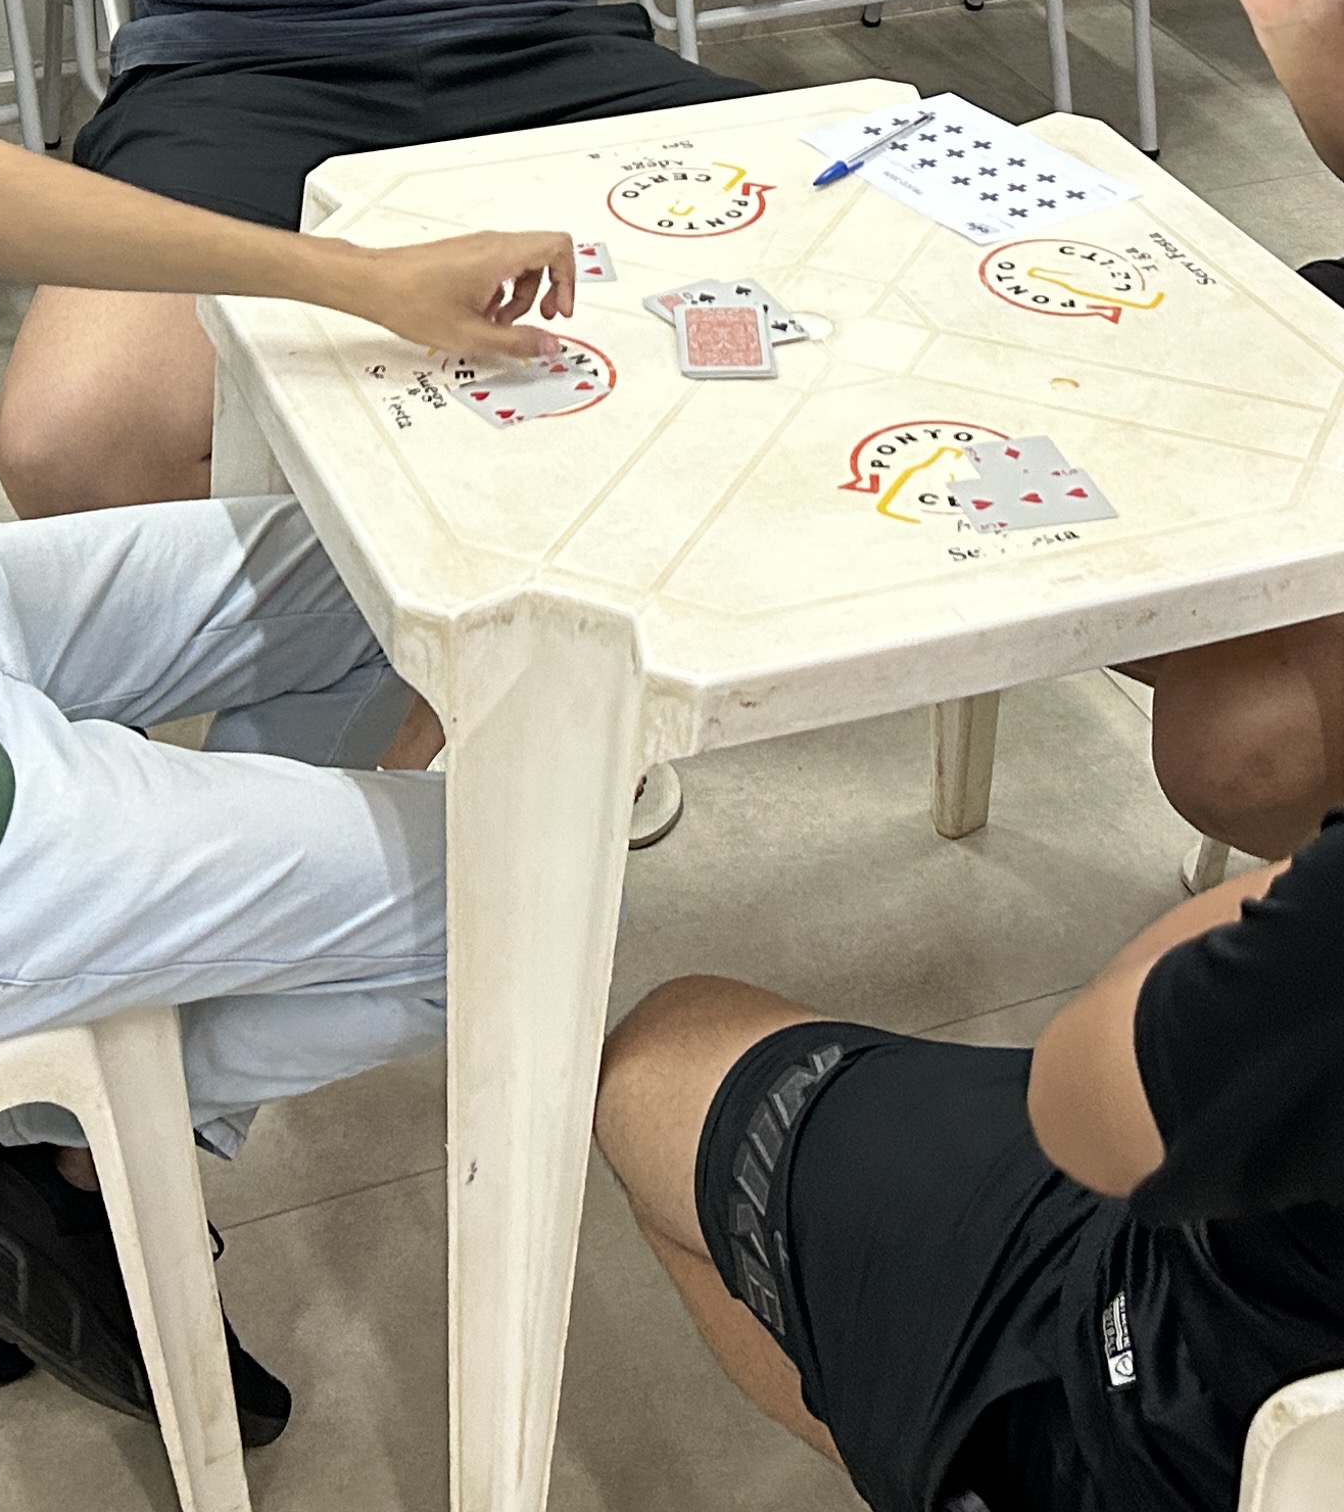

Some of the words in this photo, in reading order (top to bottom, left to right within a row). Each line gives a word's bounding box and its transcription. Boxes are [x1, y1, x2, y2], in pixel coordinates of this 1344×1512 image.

[621, 172, 712, 199] CERTO
[657, 198, 749, 230] PONTO
[996, 259, 1077, 309] PONTO
[870, 428, 974, 469] PONTO
